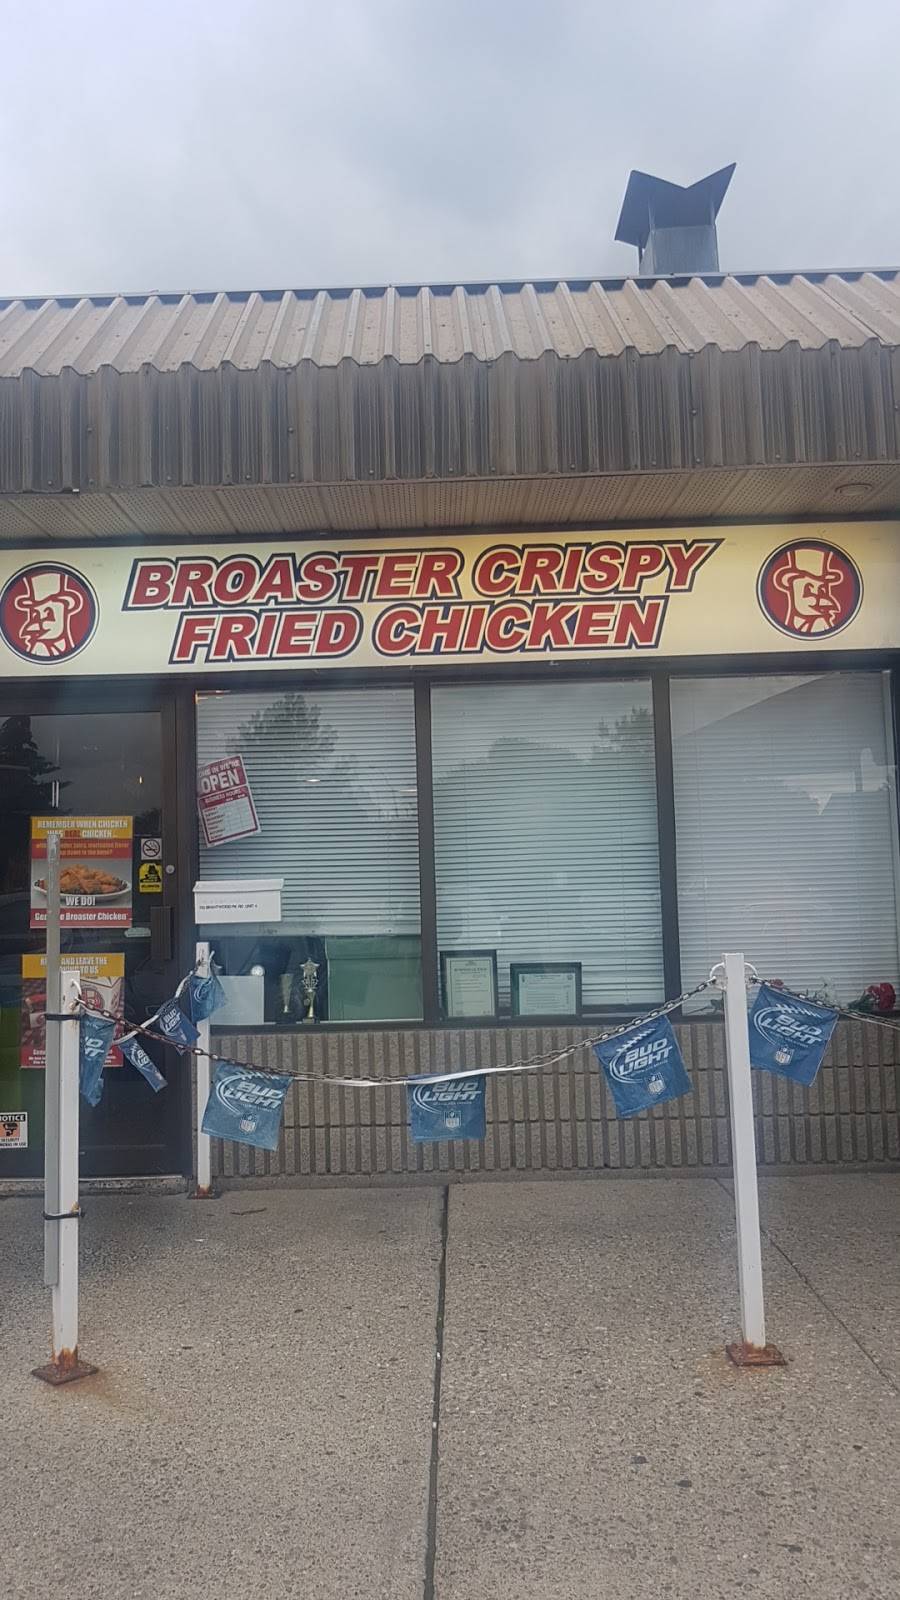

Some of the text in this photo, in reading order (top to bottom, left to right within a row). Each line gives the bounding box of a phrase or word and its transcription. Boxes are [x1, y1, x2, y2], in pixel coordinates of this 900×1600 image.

[123, 539, 725, 610] BROASTER CRISPY
[169, 596, 669, 664] FRIED CHICKEN
[201, 768, 240, 794] OPEN
[38, 819, 128, 829] REMEMBER WHEN CHICKEN
[65, 896, 96, 906] WE DO!
[65, 912, 97, 921] Broaster
[61, 957, 108, 966] AND LEAVE THE
[80, 966, 89, 974] TO
[89, 966, 98, 974] US
[760, 1018, 822, 1045] LIGHT
[775, 1013, 822, 1036] BUD
[619, 1045, 673, 1076] LIGHT
[625, 1038, 668, 1064] BUD
[237, 1081, 285, 1099] BUD
[422, 1090, 482, 1102] LIGHT
[432, 1081, 479, 1092] BUD
[224, 1087, 282, 1109] LIGHT
